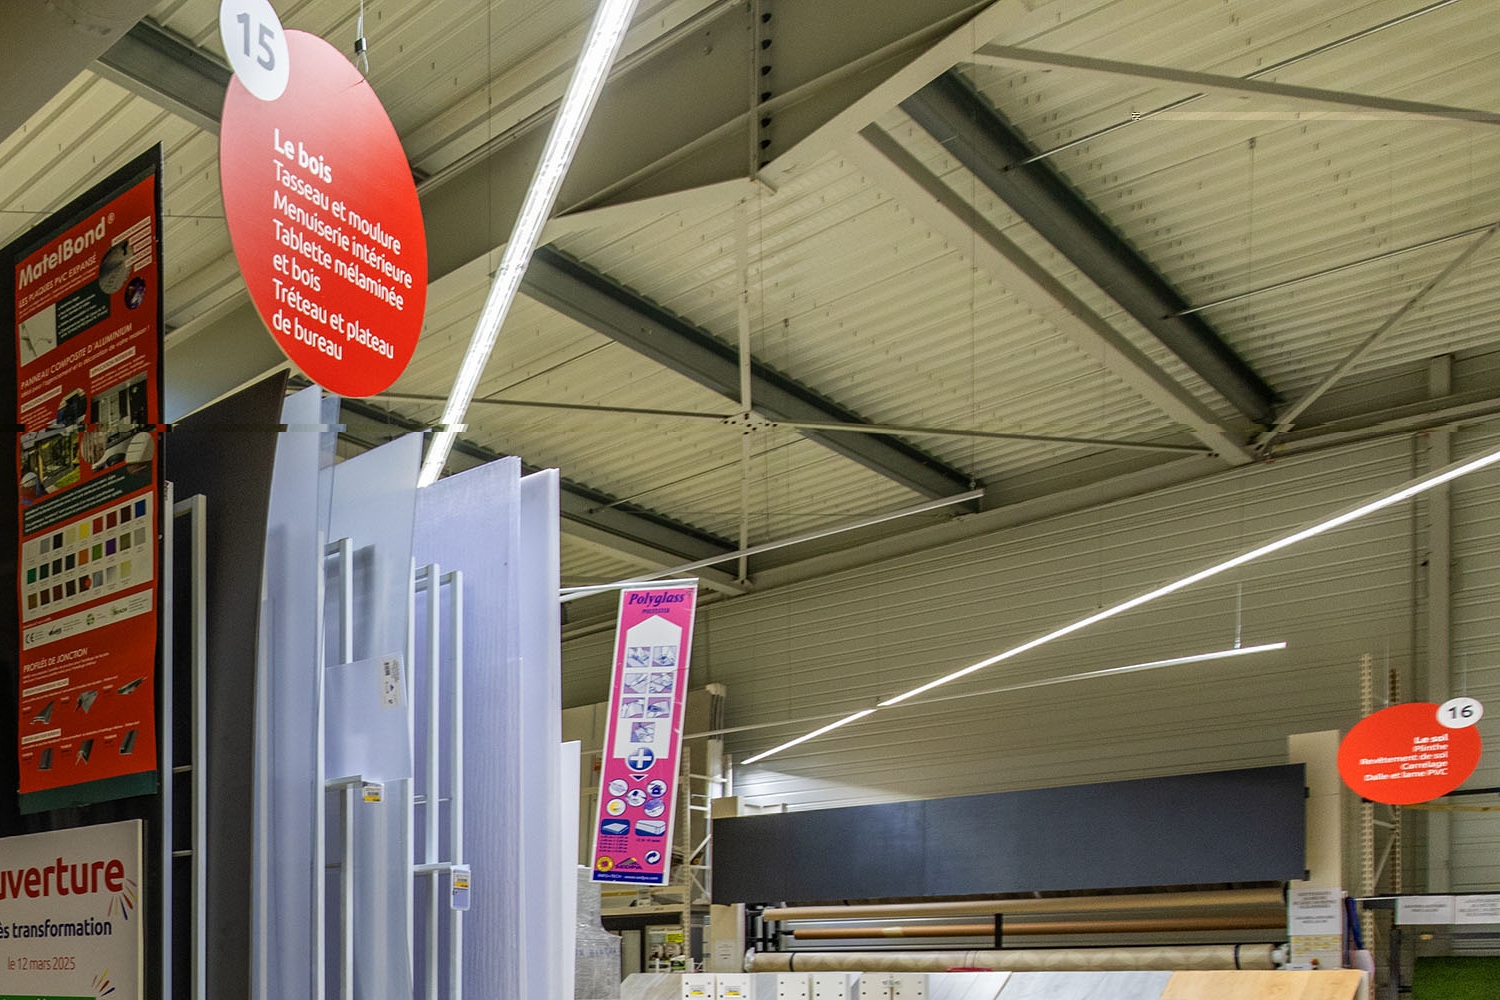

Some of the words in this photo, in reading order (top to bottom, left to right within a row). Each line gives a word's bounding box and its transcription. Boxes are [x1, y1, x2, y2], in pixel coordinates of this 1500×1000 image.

[236, 11, 276, 72] 15
[274, 127, 295, 160] Le
[298, 141, 332, 184] bois
[273, 158, 329, 211] Tasseau
[331, 200, 347, 222] et
[348, 210, 401, 255] moulure
[273, 189, 350, 251] Menuiserie
[352, 235, 413, 289] intérieure
[272, 218, 332, 270] Tablette
[334, 258, 404, 311] mélaminée
[272, 253, 290, 276] et
[291, 257, 321, 292] bois
[29, 282, 53, 302] PLAQUES
[53, 273, 68, 289] PVC
[272, 278, 327, 324] Tréteau
[329, 313, 345, 334] et
[346, 319, 394, 360] plateau
[272, 308, 292, 335] de
[294, 317, 343, 361] bureau
[20, 369, 50, 390] PANNEAU
[50, 348, 87, 373] COMPOSITE
[628, 592, 684, 607] Polyglass
[48, 656, 56, 665] DE
[56, 647, 88, 664] JONCTION
[1448, 704, 1474, 720] 16
[1413, 743, 1449, 752] Plinthe
[1414, 735, 1429, 744] Le
[1430, 733, 1449, 743] sol
[1401, 760, 1449, 771] Carrelage
[1419, 752, 1431, 760] de
[1433, 751, 1449, 759] sol
[1427, 768, 1449, 776] PVC
[12, 917, 112, 940] transformation
[7, 955, 16, 971] le
[17, 956, 29, 971] 12
[29, 958, 51, 971] mars
[52, 955, 76, 971] 2025
